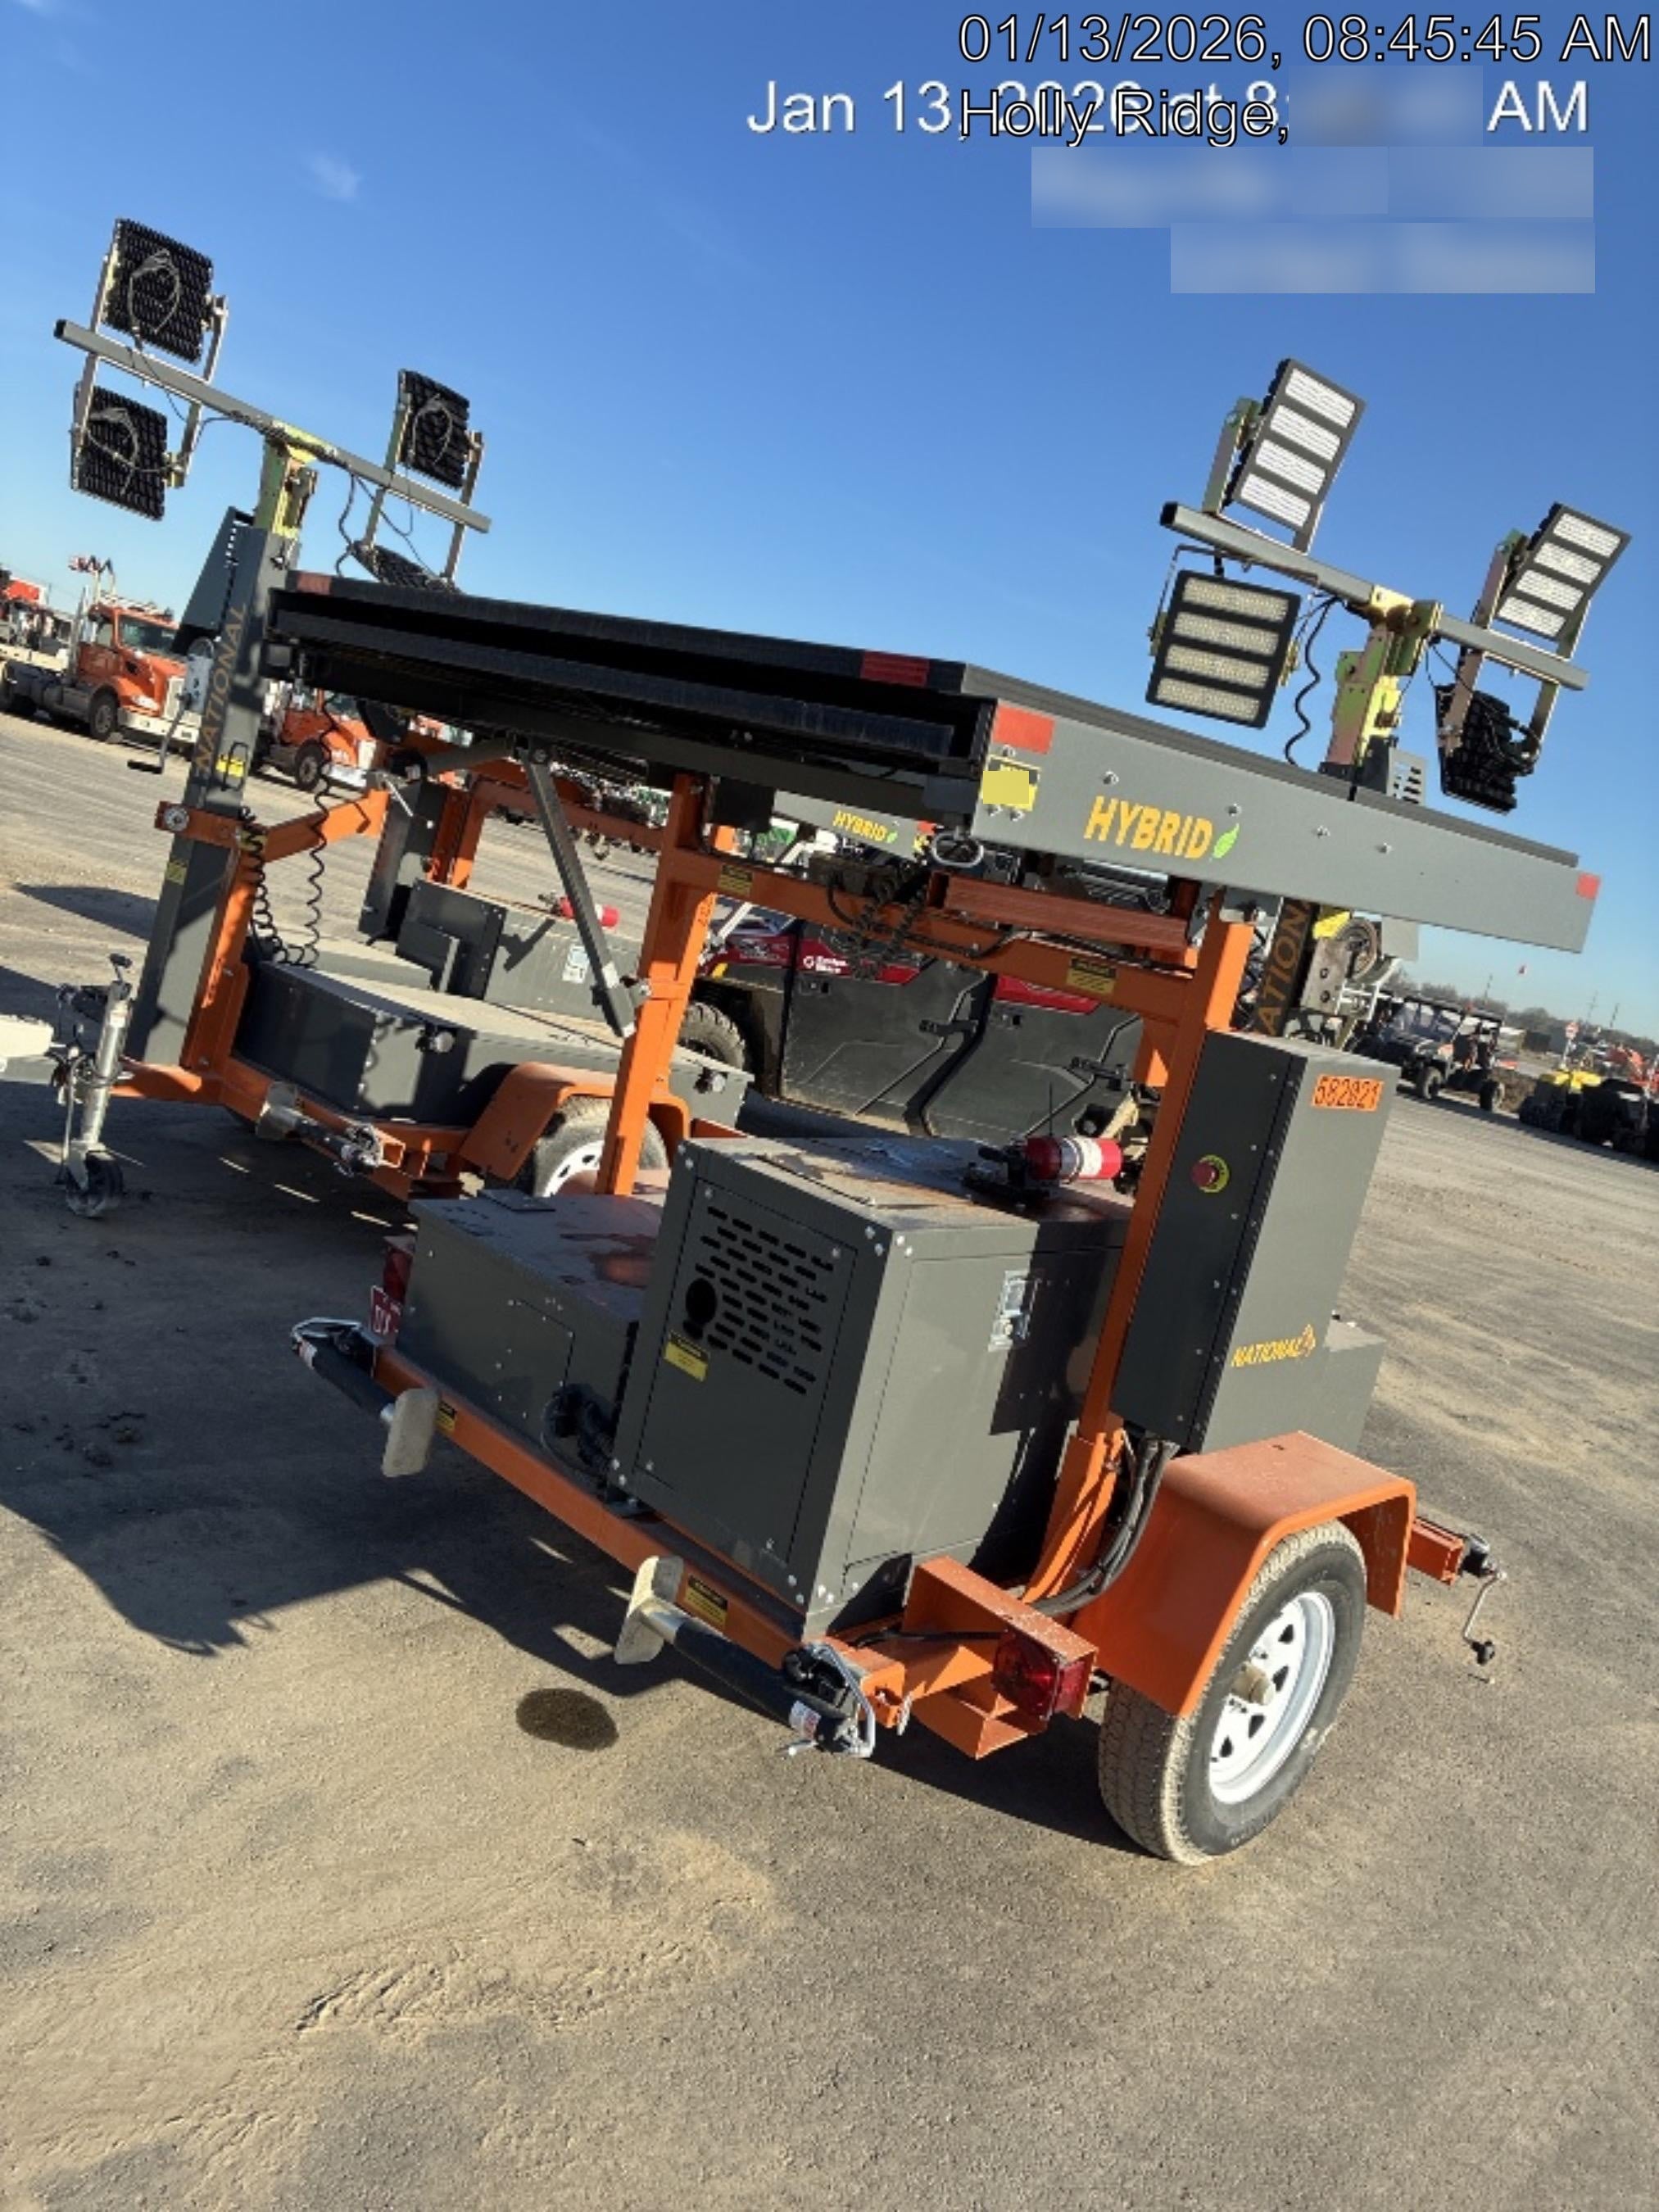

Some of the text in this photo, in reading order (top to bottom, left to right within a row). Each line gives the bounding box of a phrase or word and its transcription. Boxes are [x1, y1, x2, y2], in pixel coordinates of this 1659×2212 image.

[832, 810, 887, 842] HYBRID
[1083, 795, 1214, 859] HYBRID
[1231, 1337, 1303, 1367] NATIONAL
